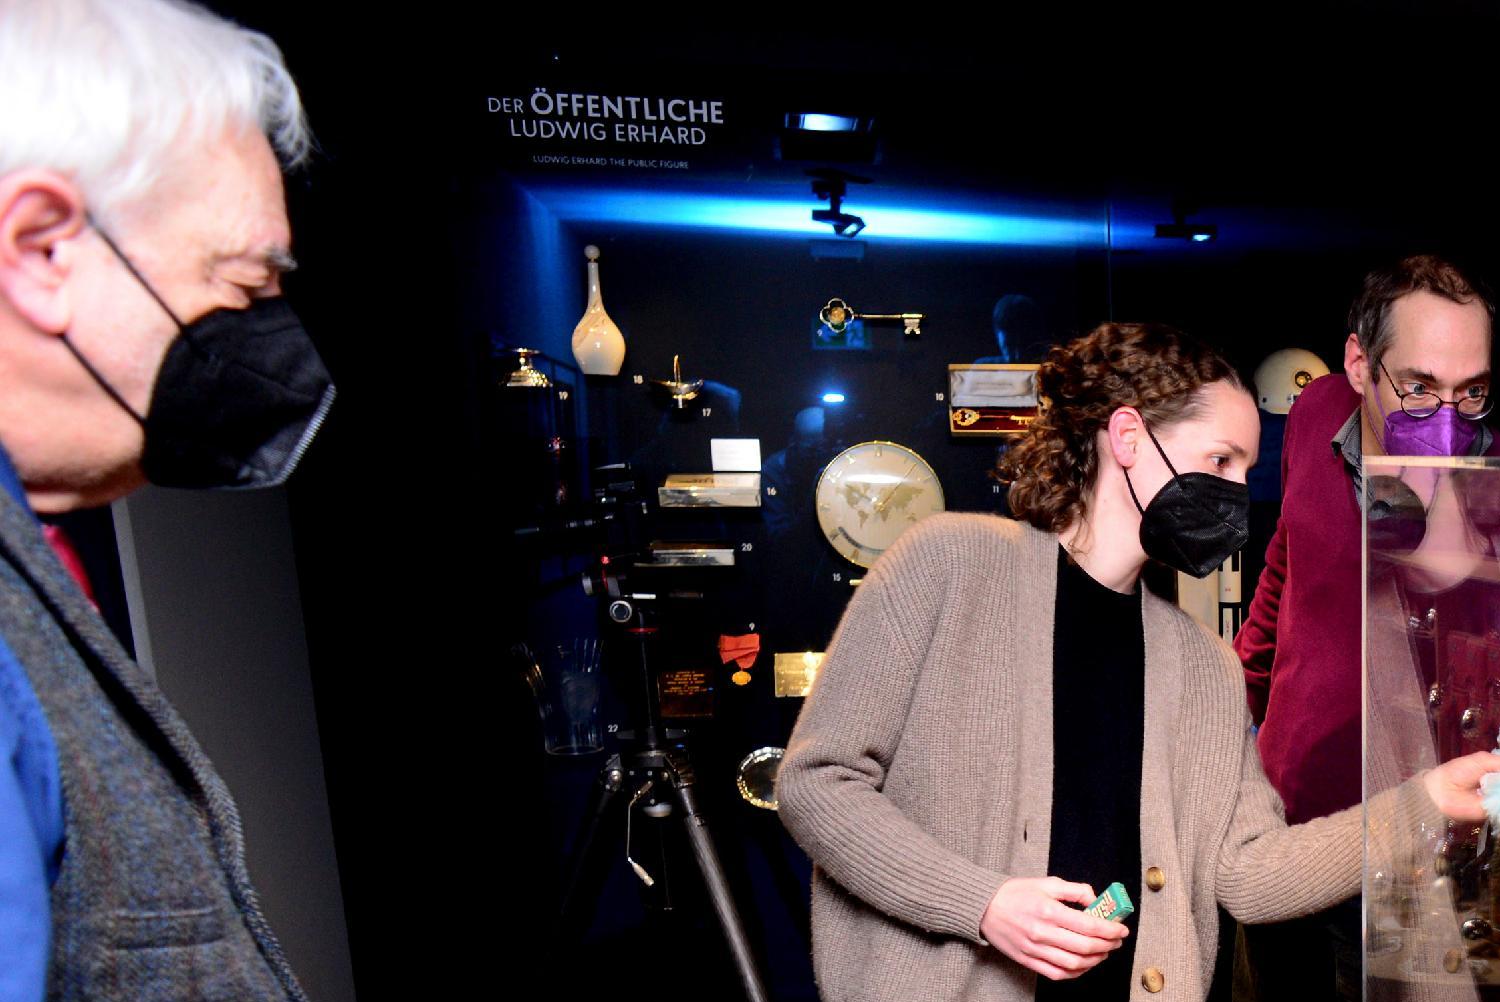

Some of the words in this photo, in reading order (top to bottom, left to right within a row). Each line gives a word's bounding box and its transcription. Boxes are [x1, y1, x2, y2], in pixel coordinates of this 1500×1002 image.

[487, 96, 524, 114] DER
[530, 87, 724, 124] ÖFFENTLICHE
[510, 118, 608, 142] LUDWIG
[615, 122, 707, 145] ERHARD
[532, 154, 570, 165] LUDWIG
[571, 156, 607, 166] ERHARD
[609, 157, 626, 167] THE
[627, 158, 658, 168] PUBLIC
[659, 160, 690, 169] FIGURE
[558, 391, 569, 400] 19
[935, 392, 944, 401] 10
[702, 407, 712, 417] 17
[766, 486, 777, 496] 16
[741, 542, 753, 552] 20
[748, 621, 756, 631] 9
